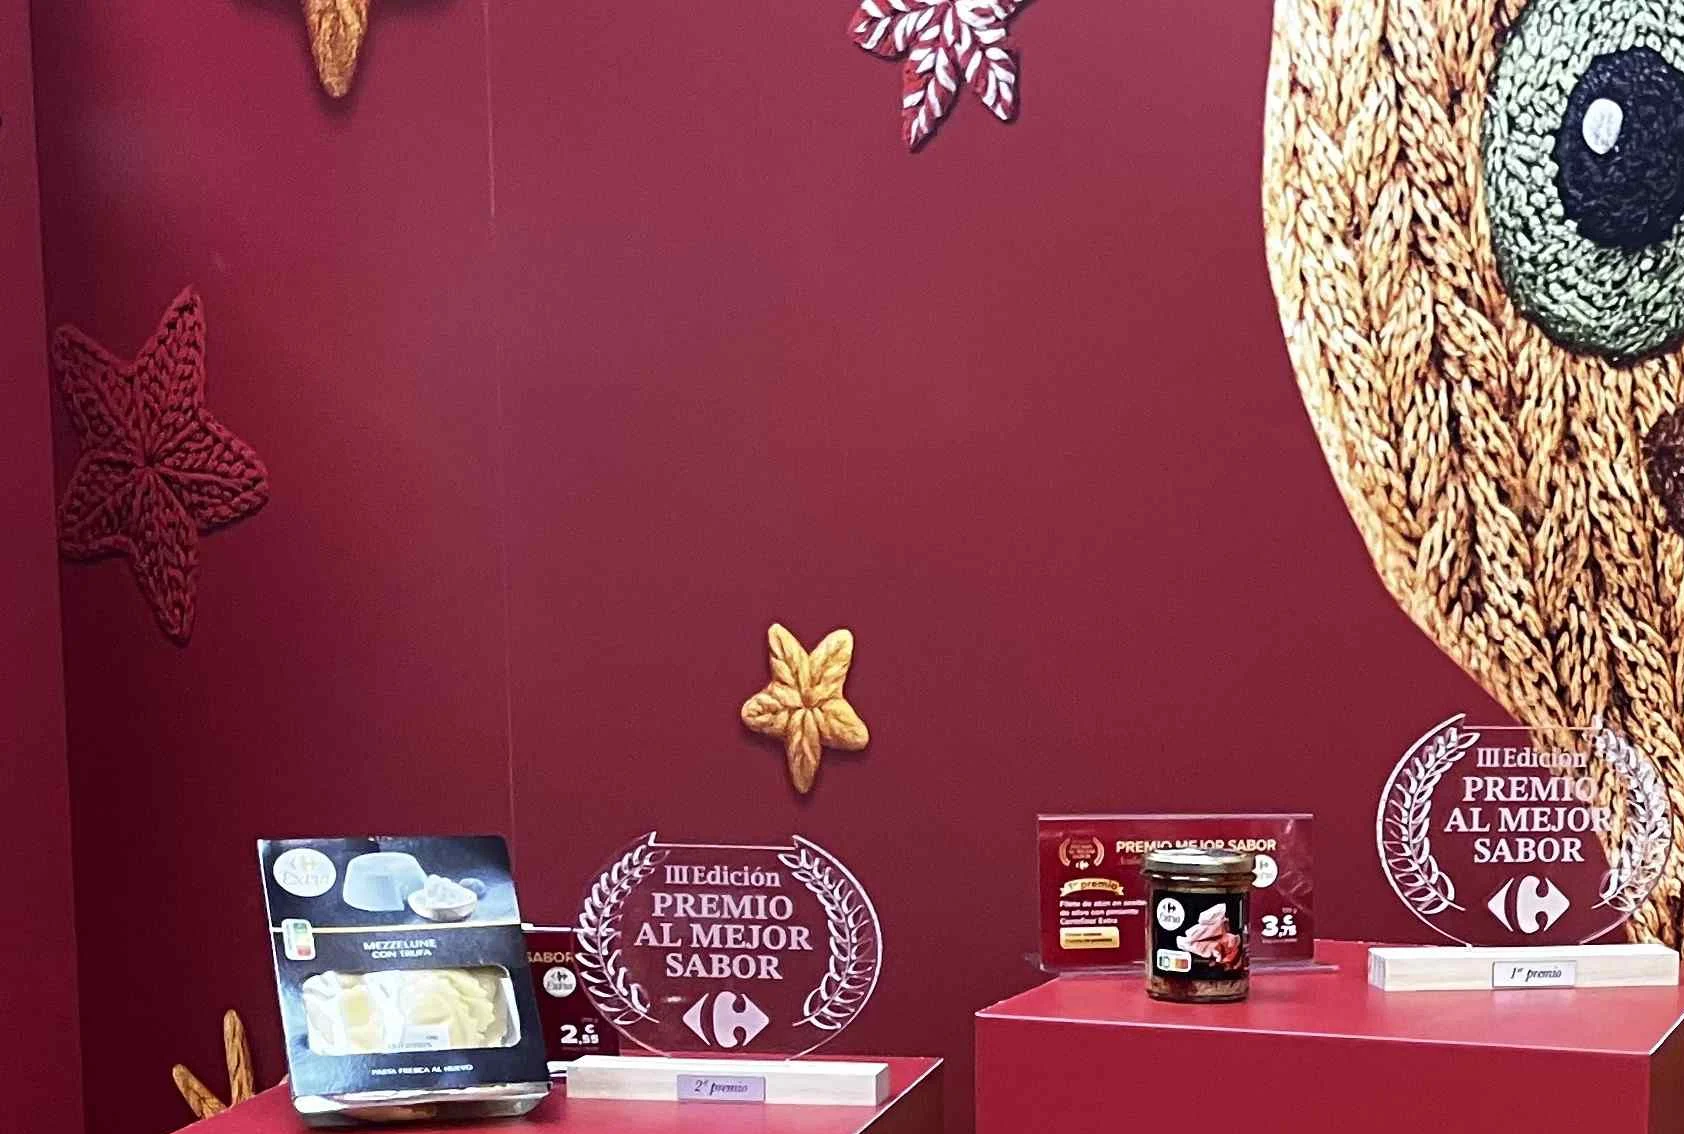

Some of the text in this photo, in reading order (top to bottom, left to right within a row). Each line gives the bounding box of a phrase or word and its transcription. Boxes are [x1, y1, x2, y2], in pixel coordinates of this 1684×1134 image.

[1476, 744, 1588, 768] III Edición
[1462, 776, 1599, 802] PREMIO
[1443, 807, 1612, 833] AL MEJOR
[1227, 838, 1277, 851] SABOR
[1473, 837, 1585, 863] SABOR
[664, 865, 781, 887] III Edición
[651, 892, 794, 920] PREMIO
[633, 922, 813, 950] AL MEJOR
[371, 950, 397, 959] CON
[665, 953, 783, 980] SABOR
[1525, 966, 1562, 983] premio
